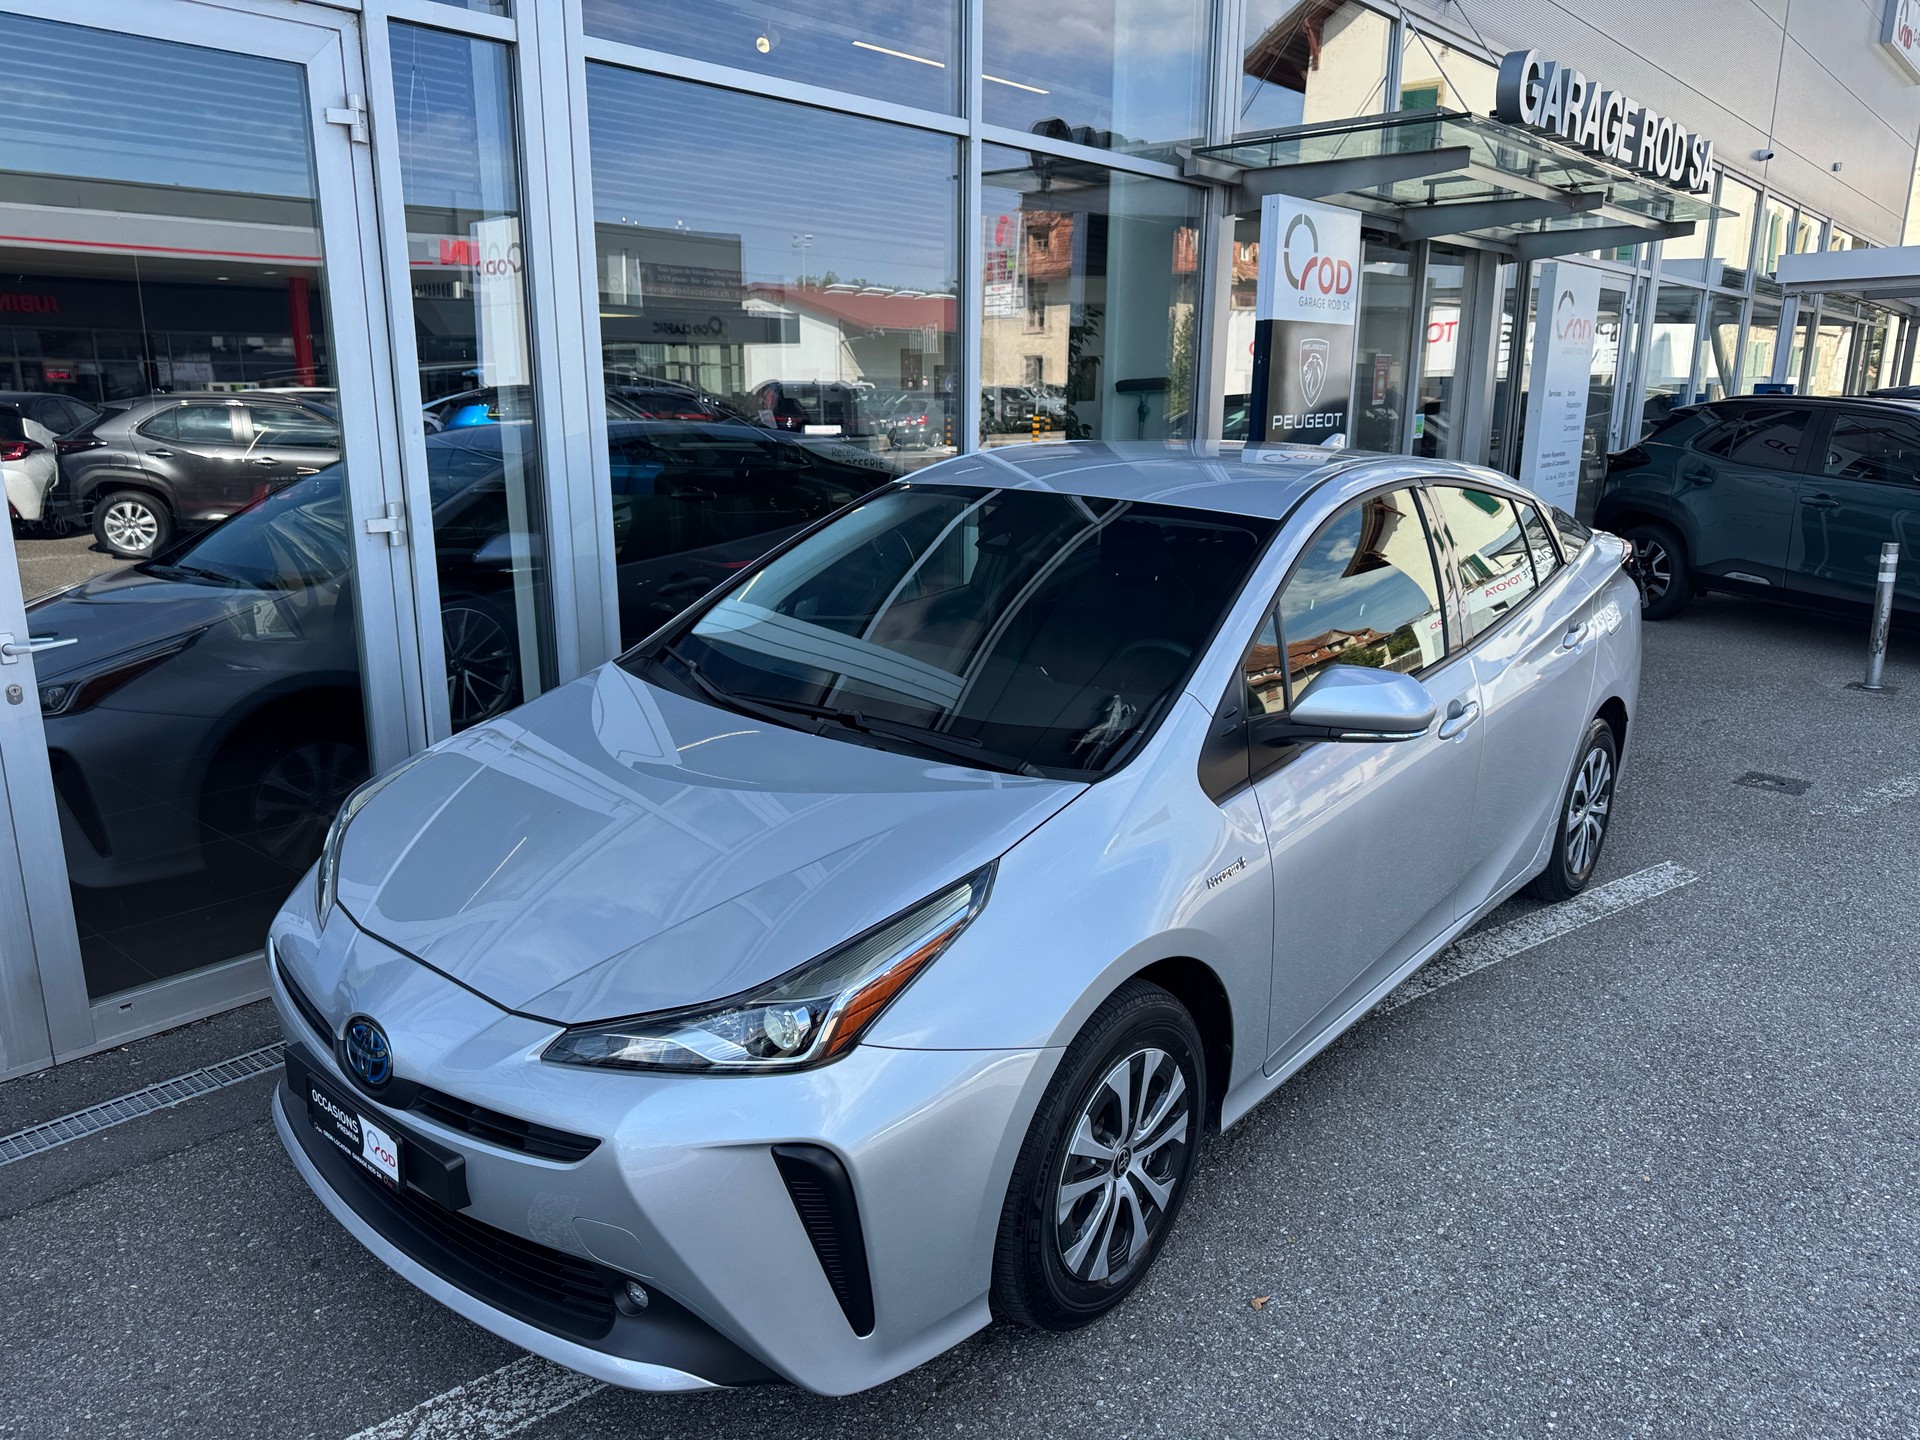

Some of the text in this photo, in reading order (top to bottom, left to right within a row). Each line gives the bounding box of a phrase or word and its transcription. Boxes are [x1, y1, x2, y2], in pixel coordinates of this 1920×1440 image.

[1518, 48, 1714, 191] GARAGE ROD SA
[1298, 296, 1351, 311] GARAGE ROD SA
[1302, 343, 1327, 351] PEUGEOT
[1271, 412, 1343, 431] PEUGEOT
[311, 1089, 359, 1134] OCCASIONS
